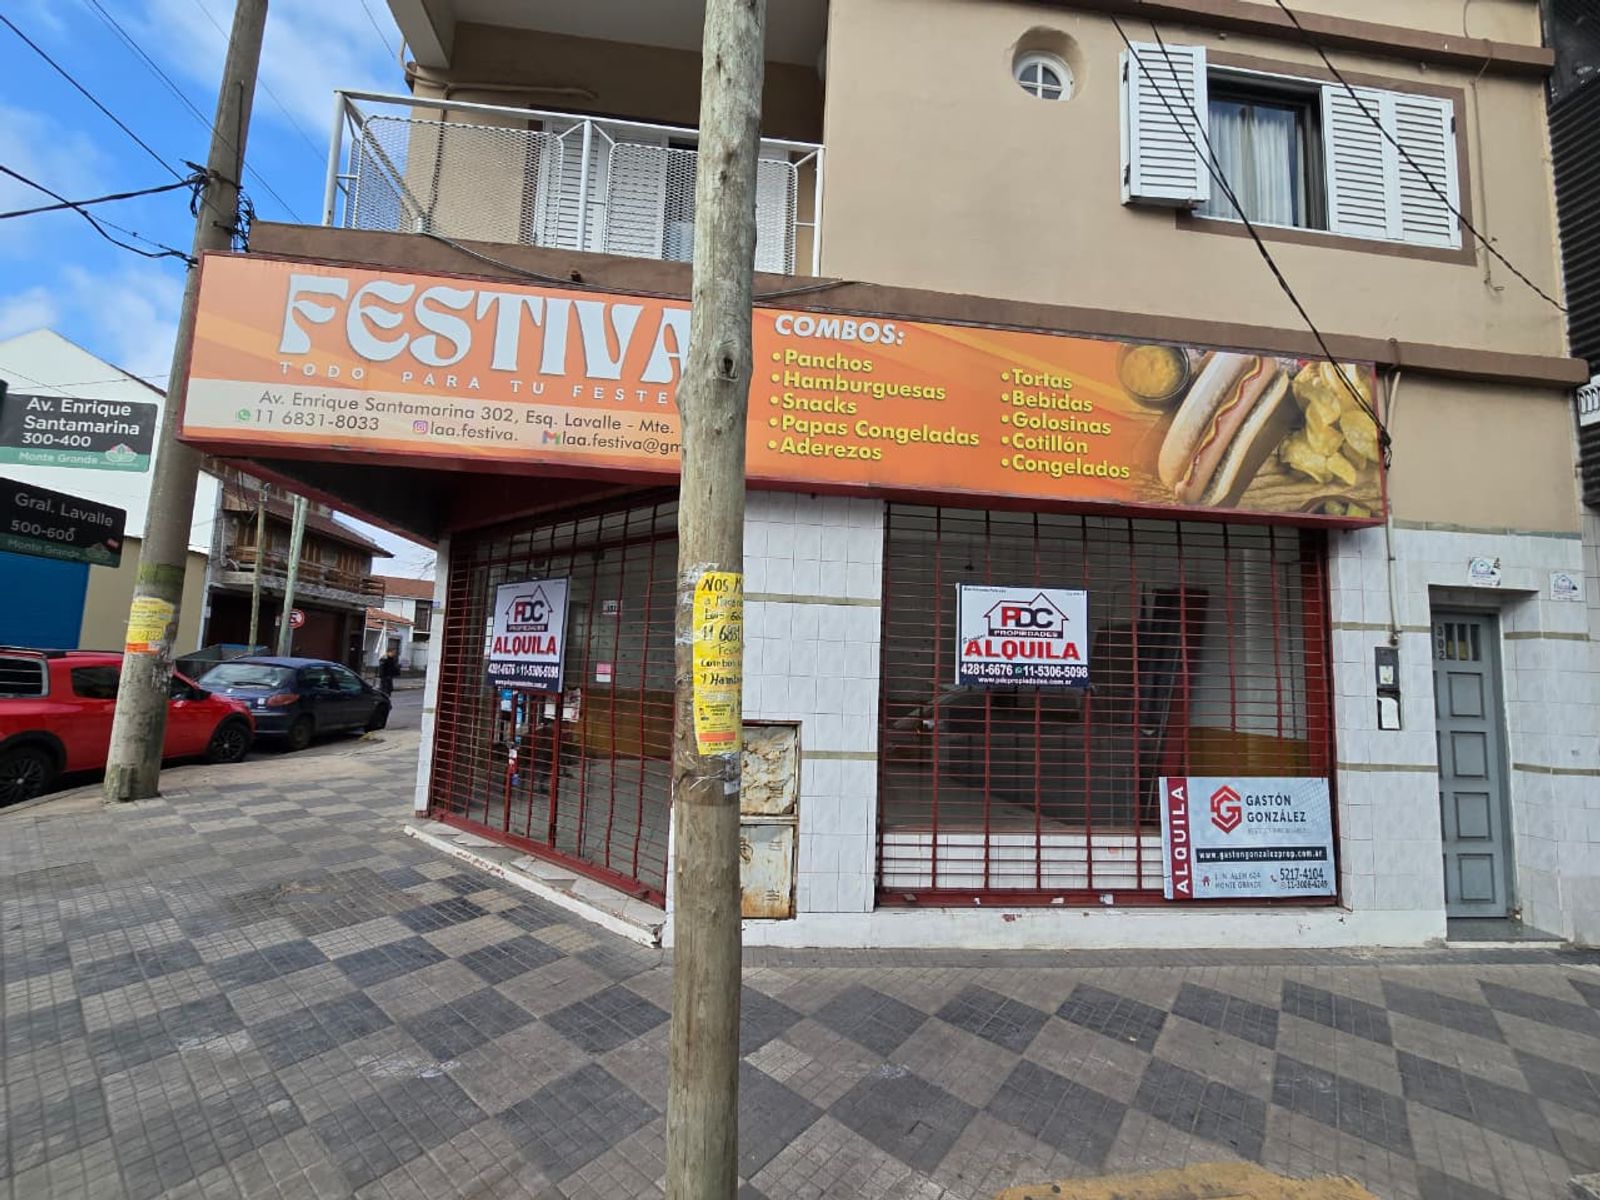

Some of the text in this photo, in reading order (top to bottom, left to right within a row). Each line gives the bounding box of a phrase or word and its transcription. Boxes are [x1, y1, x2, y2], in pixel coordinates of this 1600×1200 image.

[279, 273, 692, 384] FESTIVA
[775, 314, 905, 345] COMBOS:
[784, 348, 873, 372] Panchos
[279, 361, 669, 404] TODO PARA TU FESTE
[783, 370, 946, 400] Hamburguesas
[1012, 368, 1073, 389] Tortas
[26, 397, 131, 417] Av. Enrique
[782, 392, 858, 414] Snacks
[1012, 389, 1093, 412] Bebidas
[255, 409, 380, 431] 11 6831-8033
[259, 390, 285, 405] Av.
[292, 392, 359, 411] Enrique
[364, 397, 474, 419] Santamarina
[481, 406, 518, 424] 302,
[526, 410, 558, 429] Esq.
[565, 413, 621, 431] Lavalle
[639, 420, 674, 434] Mte.
[1012, 411, 1111, 435] Golosinas
[23, 415, 140, 435] Santamarina
[430, 421, 518, 442] laa.festiva.
[781, 414, 980, 446] Papas Congeladas
[22, 432, 91, 447] 300-400
[562, 433, 682, 455] laa.festiva@gm
[779, 436, 882, 460] Aderezos
[1012, 432, 1088, 454] Cotillón
[19, 451, 54, 463] Monte
[58, 453, 99, 465] Grande
[1012, 454, 1130, 479] Congelados
[15, 492, 113, 527] Gral. Lavalle
[10, 519, 75, 542] 500-600
[514, 600, 544, 622] PDC
[1001, 606, 1054, 628] PDC
[994, 630, 1058, 638] PROPIEDADES
[493, 636, 557, 656] ALQUILA
[964, 639, 1081, 660] ALQUILA
[961, 663, 1088, 678] 4281-6676 11-5306-5098
[1246, 792, 1291, 806] GASTÓN
[1247, 809, 1307, 823] GONZÁLEZ
[1171, 785, 1190, 894] ALQUILA
[1280, 867, 1324, 881] 5217-4104
